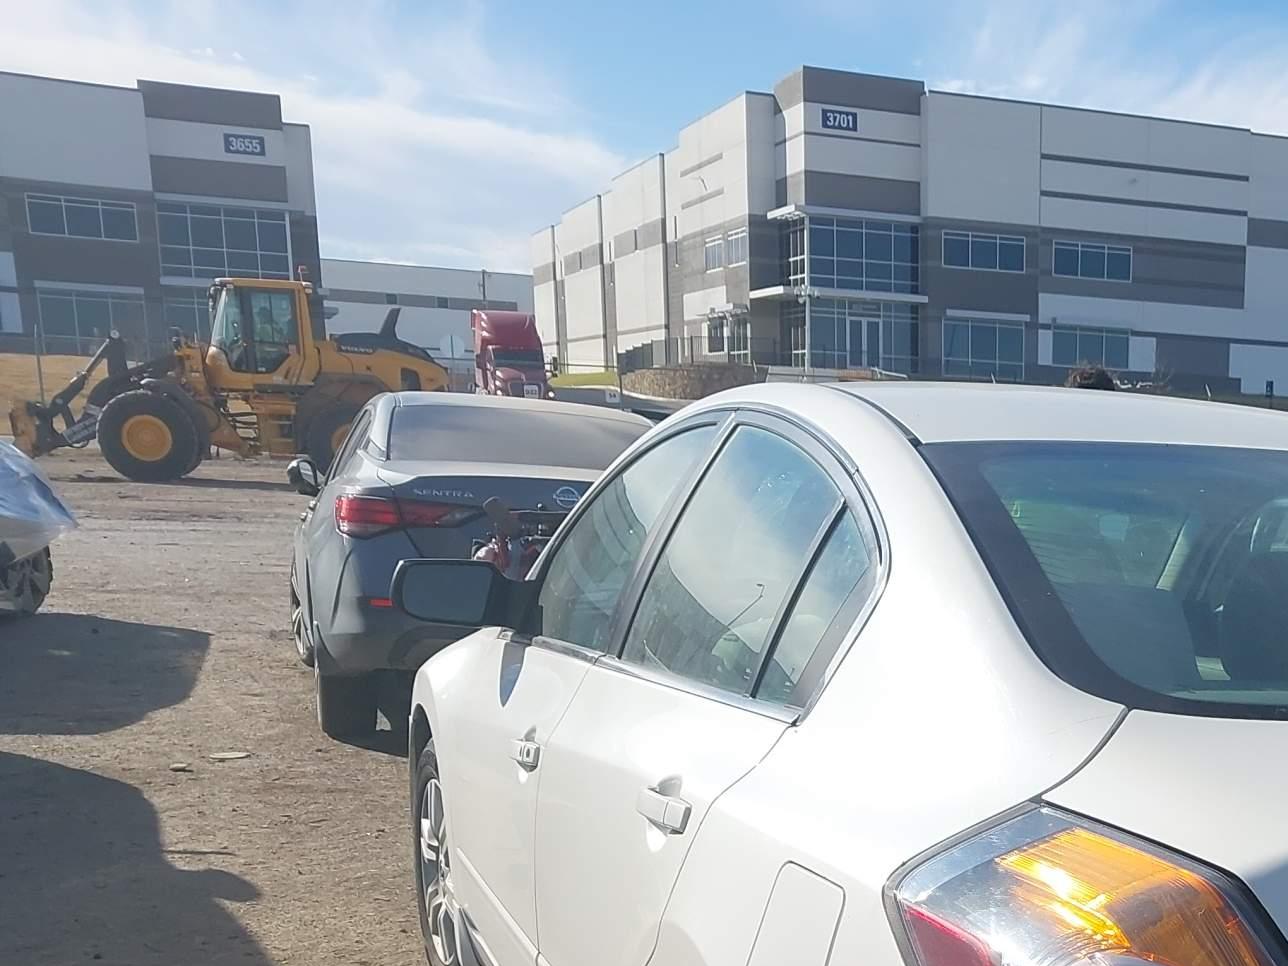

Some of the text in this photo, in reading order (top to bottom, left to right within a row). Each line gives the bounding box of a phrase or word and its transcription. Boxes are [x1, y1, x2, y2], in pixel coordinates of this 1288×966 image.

[826, 112, 853, 128] 3701
[228, 137, 261, 152] 3655
[412, 488, 475, 498] SENTRA
